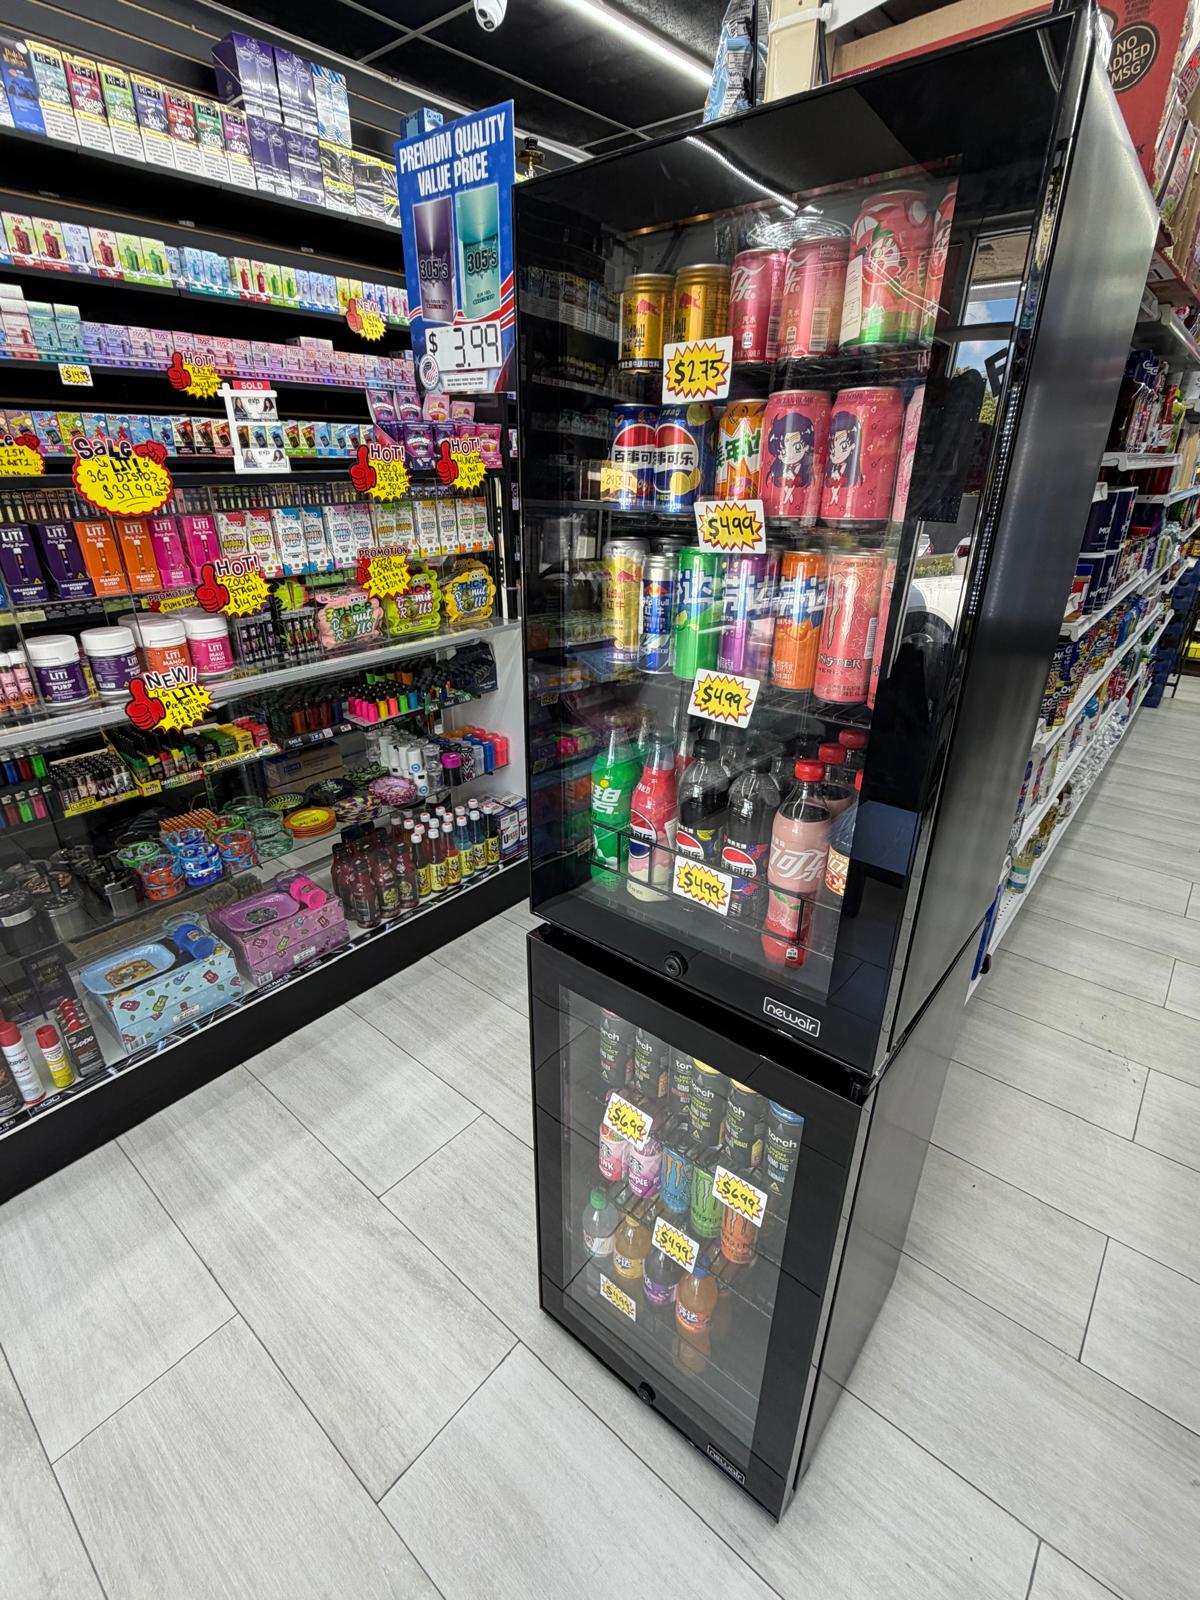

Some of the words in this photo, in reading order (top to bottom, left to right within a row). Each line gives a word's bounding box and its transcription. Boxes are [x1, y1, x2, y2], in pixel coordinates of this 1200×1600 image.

[1116, 35, 1138, 55] NO
[1111, 60, 1142, 85] MSG
[399, 131, 453, 174] PREMIUM
[454, 112, 506, 157] QUALITY
[417, 163, 452, 197] VALUE
[453, 151, 489, 187] PRICE
[183, 351, 216, 368] HOT!
[674, 359, 722, 386] $2.75
[241, 382, 264, 390] SOLD
[370, 443, 405, 463] HOT!
[452, 438, 481, 455] HOT!
[46, 528, 68, 538] LIT!
[86, 526, 106, 537] LIT!
[124, 524, 143, 534] LIT!
[154, 522, 171, 531] LIT!
[193, 520, 210, 529] LIT!
[708, 514, 754, 540] $4.99
[1, 531, 25, 541] LIT!
[359, 547, 407, 558] PROMOTION
[216, 555, 259, 576] HOT!
[166, 651, 180, 660] LIT!
[208, 644, 222, 652] LIT!
[163, 658, 186, 666] MANGO
[49, 671, 68, 681] LIT!
[145, 666, 197, 690] NEW!
[701, 684, 743, 712] $4.99
[684, 870, 720, 901] $4.99
[766, 1003, 816, 1032] newair
[613, 1107, 644, 1134] $6.99
[768, 1127, 797, 1149] torch
[722, 1180, 755, 1210] $6.99
[661, 1231, 690, 1258] $4.99
